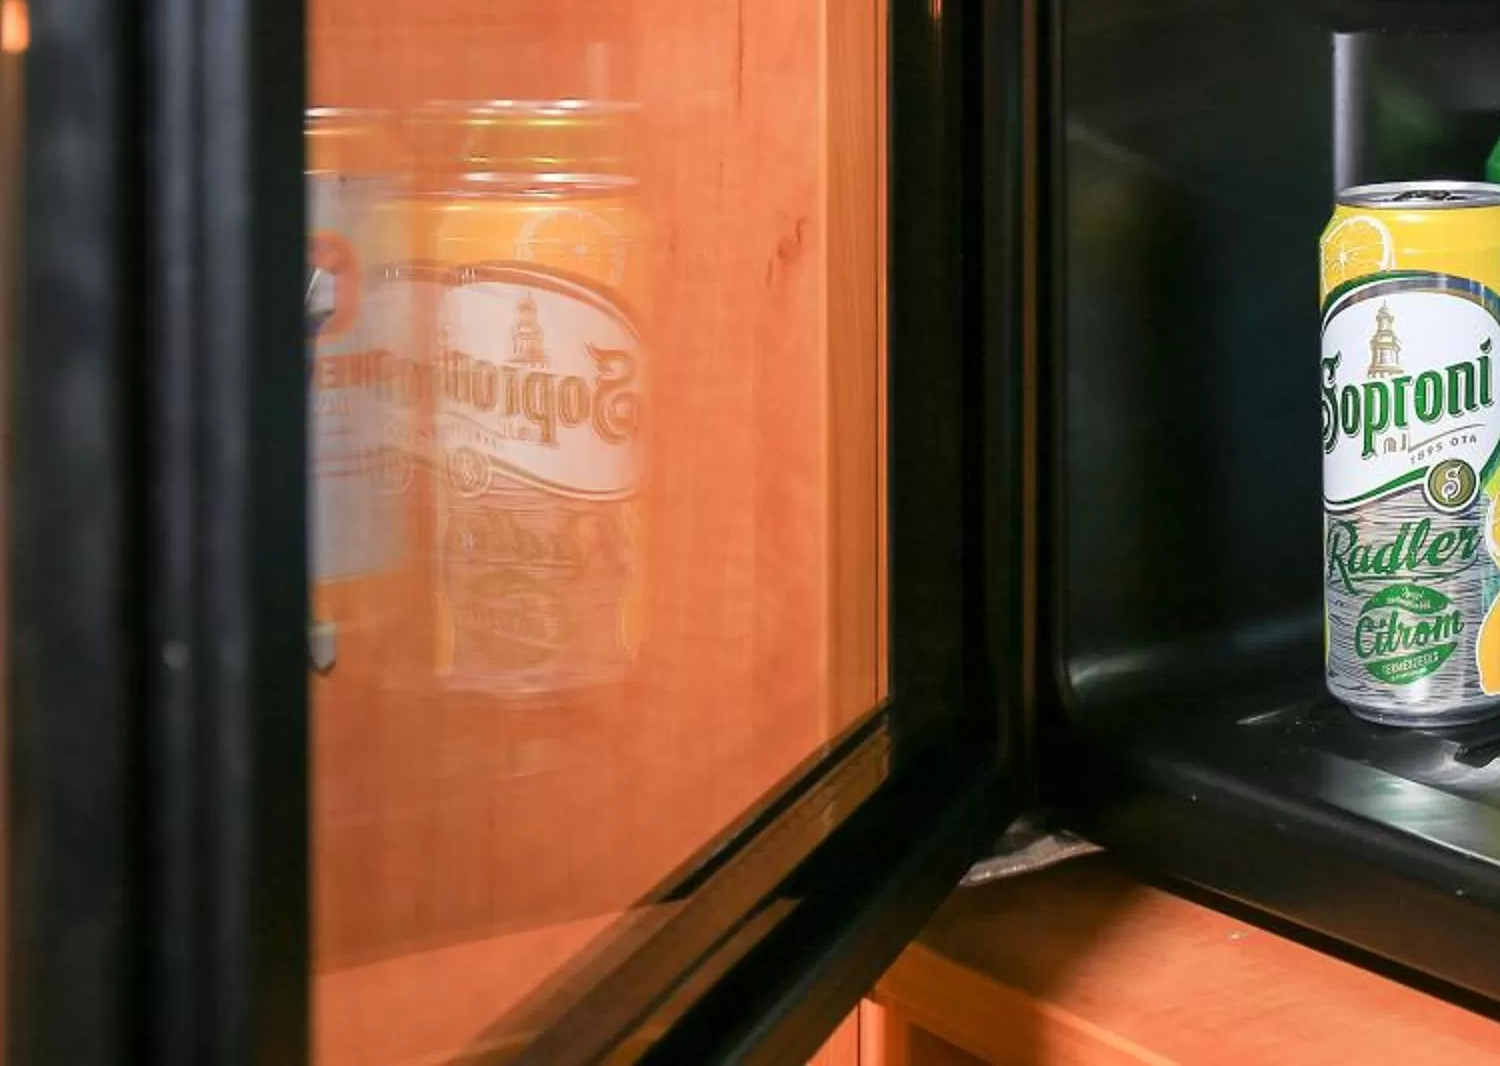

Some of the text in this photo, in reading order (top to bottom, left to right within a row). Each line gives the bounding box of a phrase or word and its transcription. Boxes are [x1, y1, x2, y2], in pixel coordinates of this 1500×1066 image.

[1322, 336, 1495, 461] Soproni
[1328, 518, 1481, 596] Radler
[1356, 610, 1464, 659] Citrom
